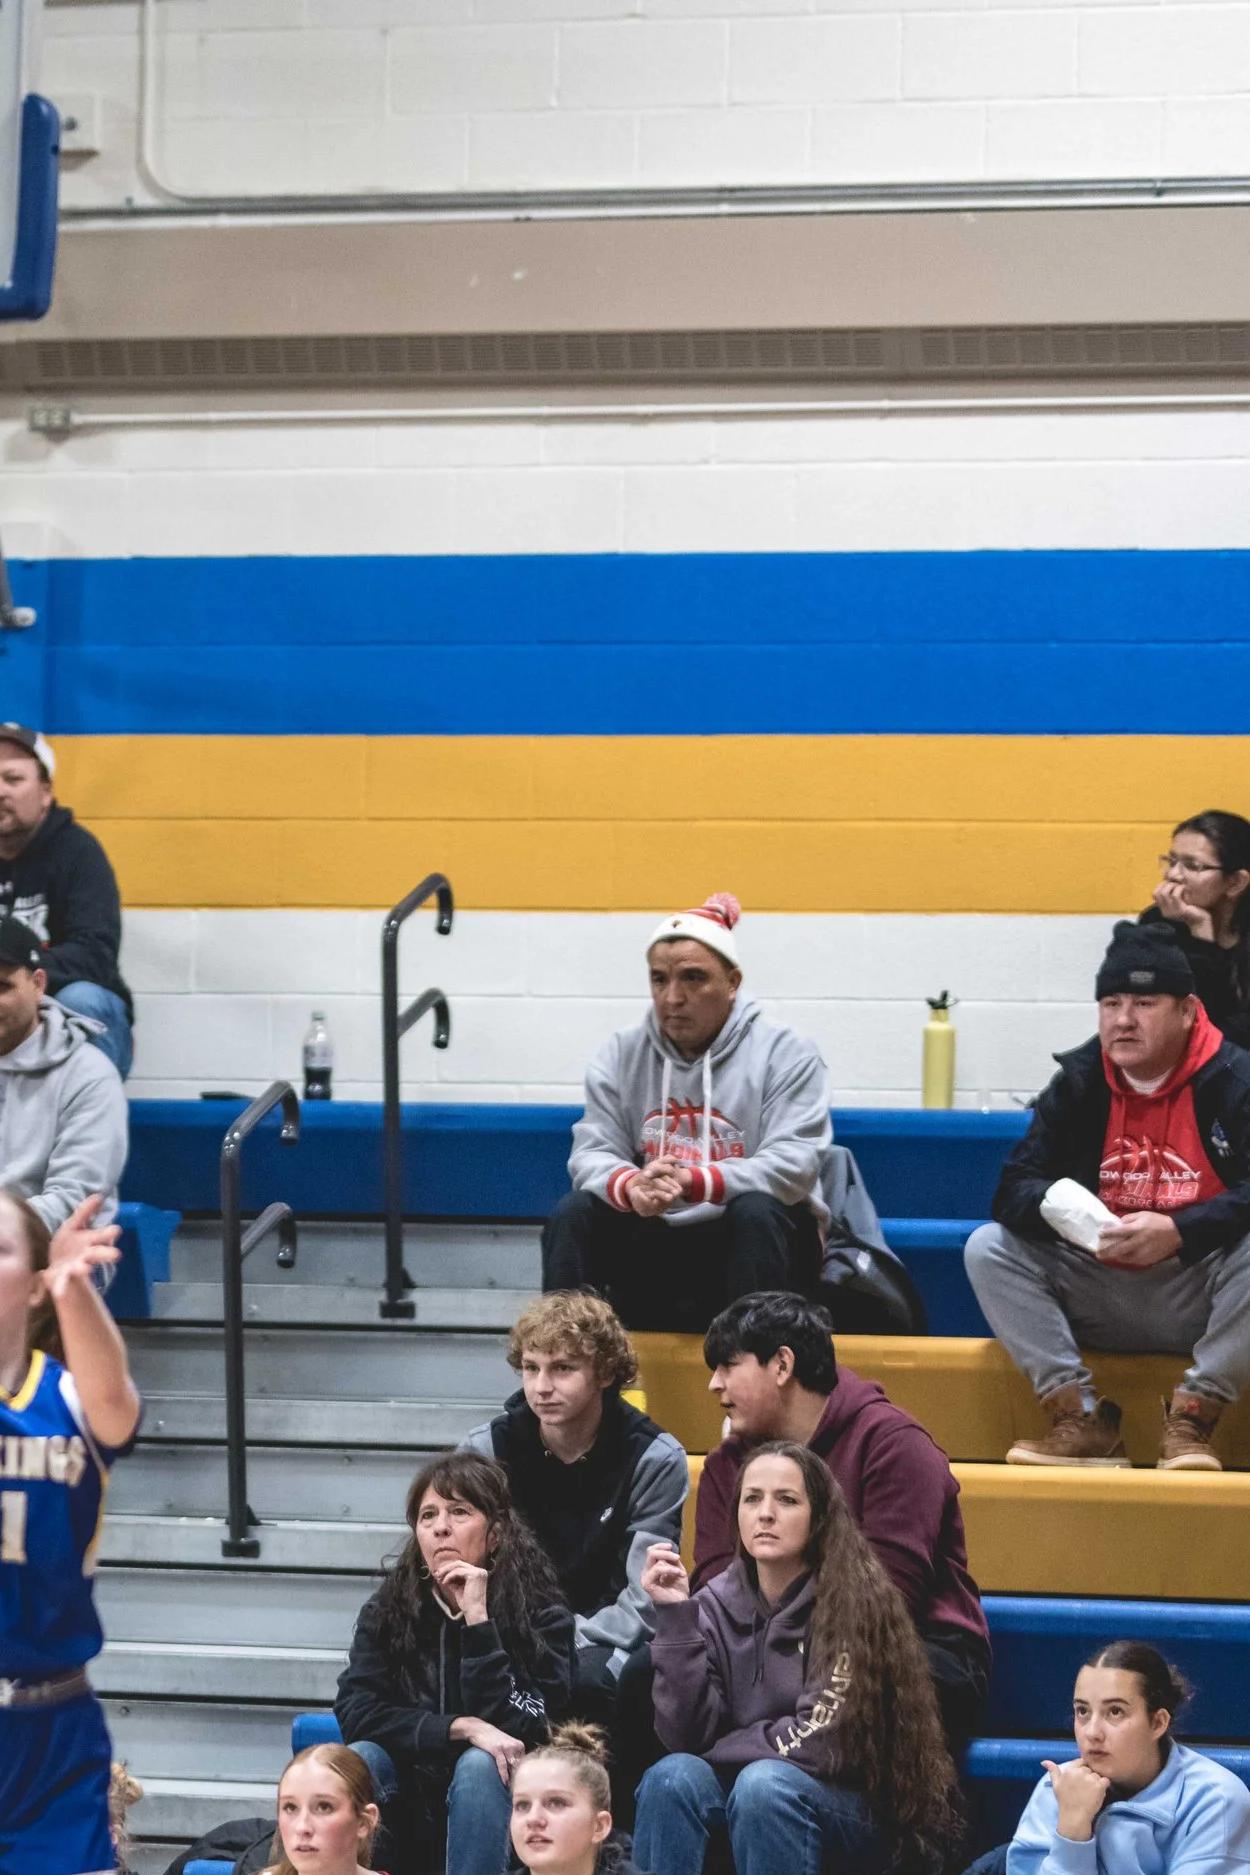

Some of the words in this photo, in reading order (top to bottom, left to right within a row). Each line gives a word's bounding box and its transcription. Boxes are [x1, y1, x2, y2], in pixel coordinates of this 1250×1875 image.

[1159, 1170, 1202, 1180] ALLEY
[1, 1491, 28, 1565] 1
[775, 1651, 851, 1757] arhartt
